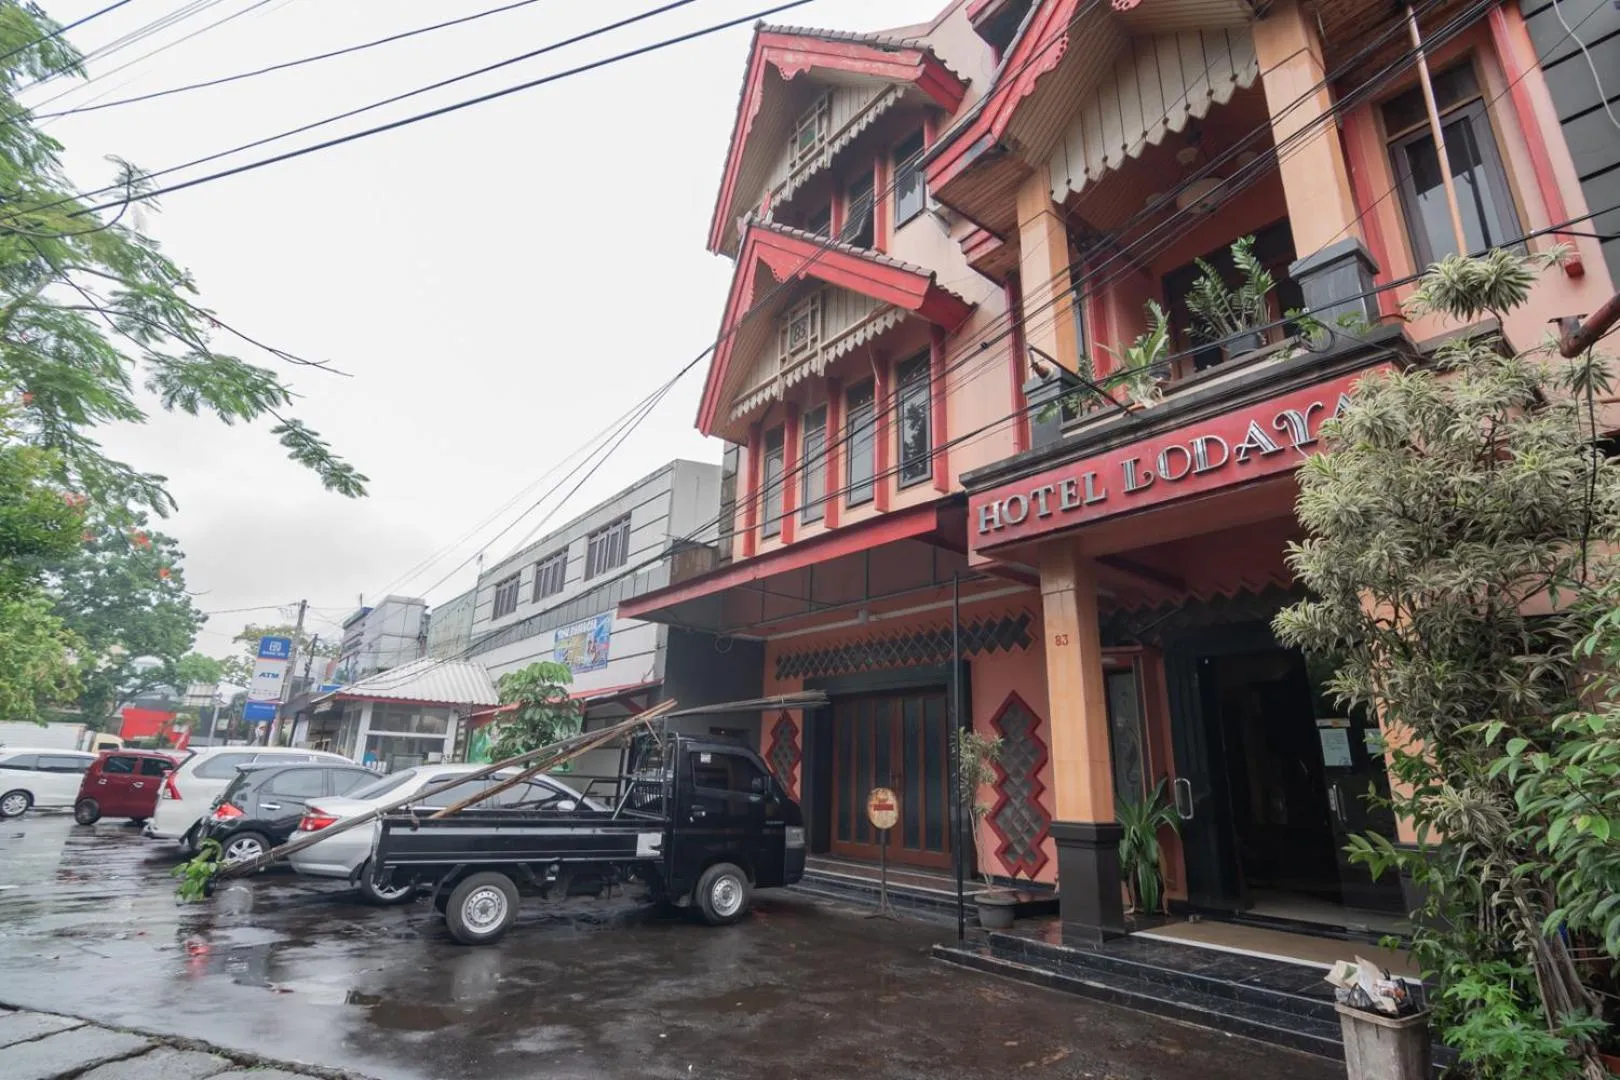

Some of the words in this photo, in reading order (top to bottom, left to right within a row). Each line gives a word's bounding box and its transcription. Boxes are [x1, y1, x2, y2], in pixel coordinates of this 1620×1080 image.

[977, 471, 1108, 534] HOTEL
[1055, 634, 1069, 646] 83
[259, 671, 280, 679] ATM
